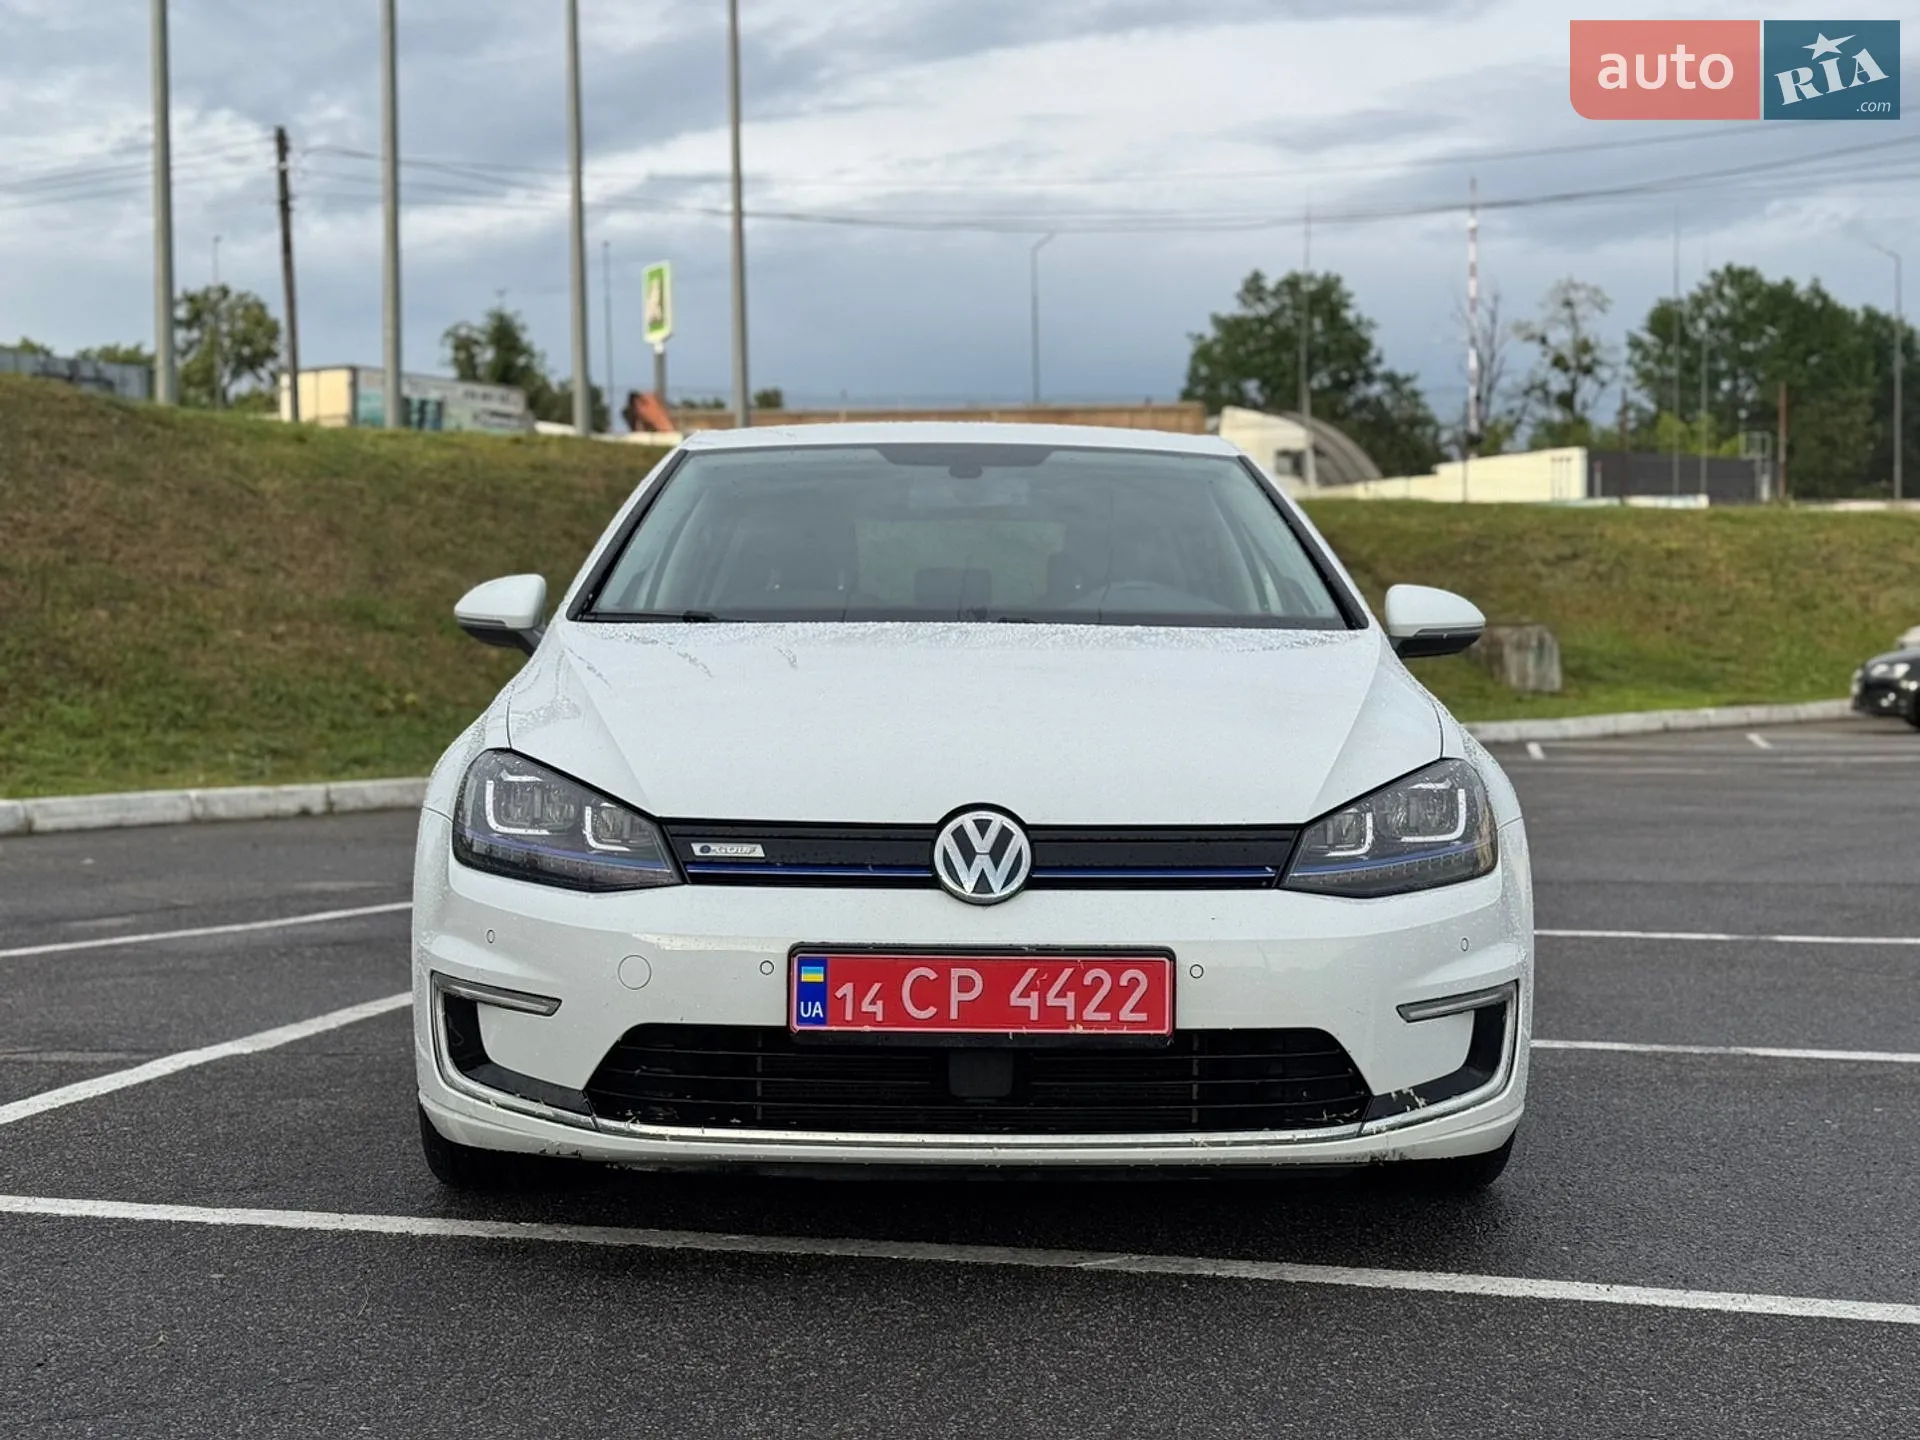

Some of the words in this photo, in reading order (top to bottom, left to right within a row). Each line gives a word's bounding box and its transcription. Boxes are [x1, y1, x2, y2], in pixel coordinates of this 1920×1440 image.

[939, 810, 1028, 898] VW
[800, 1001, 824, 1018] UA
[834, 982, 885, 1022] 14
[901, 966, 984, 1021] CP
[1009, 967, 1149, 1022] 4422
